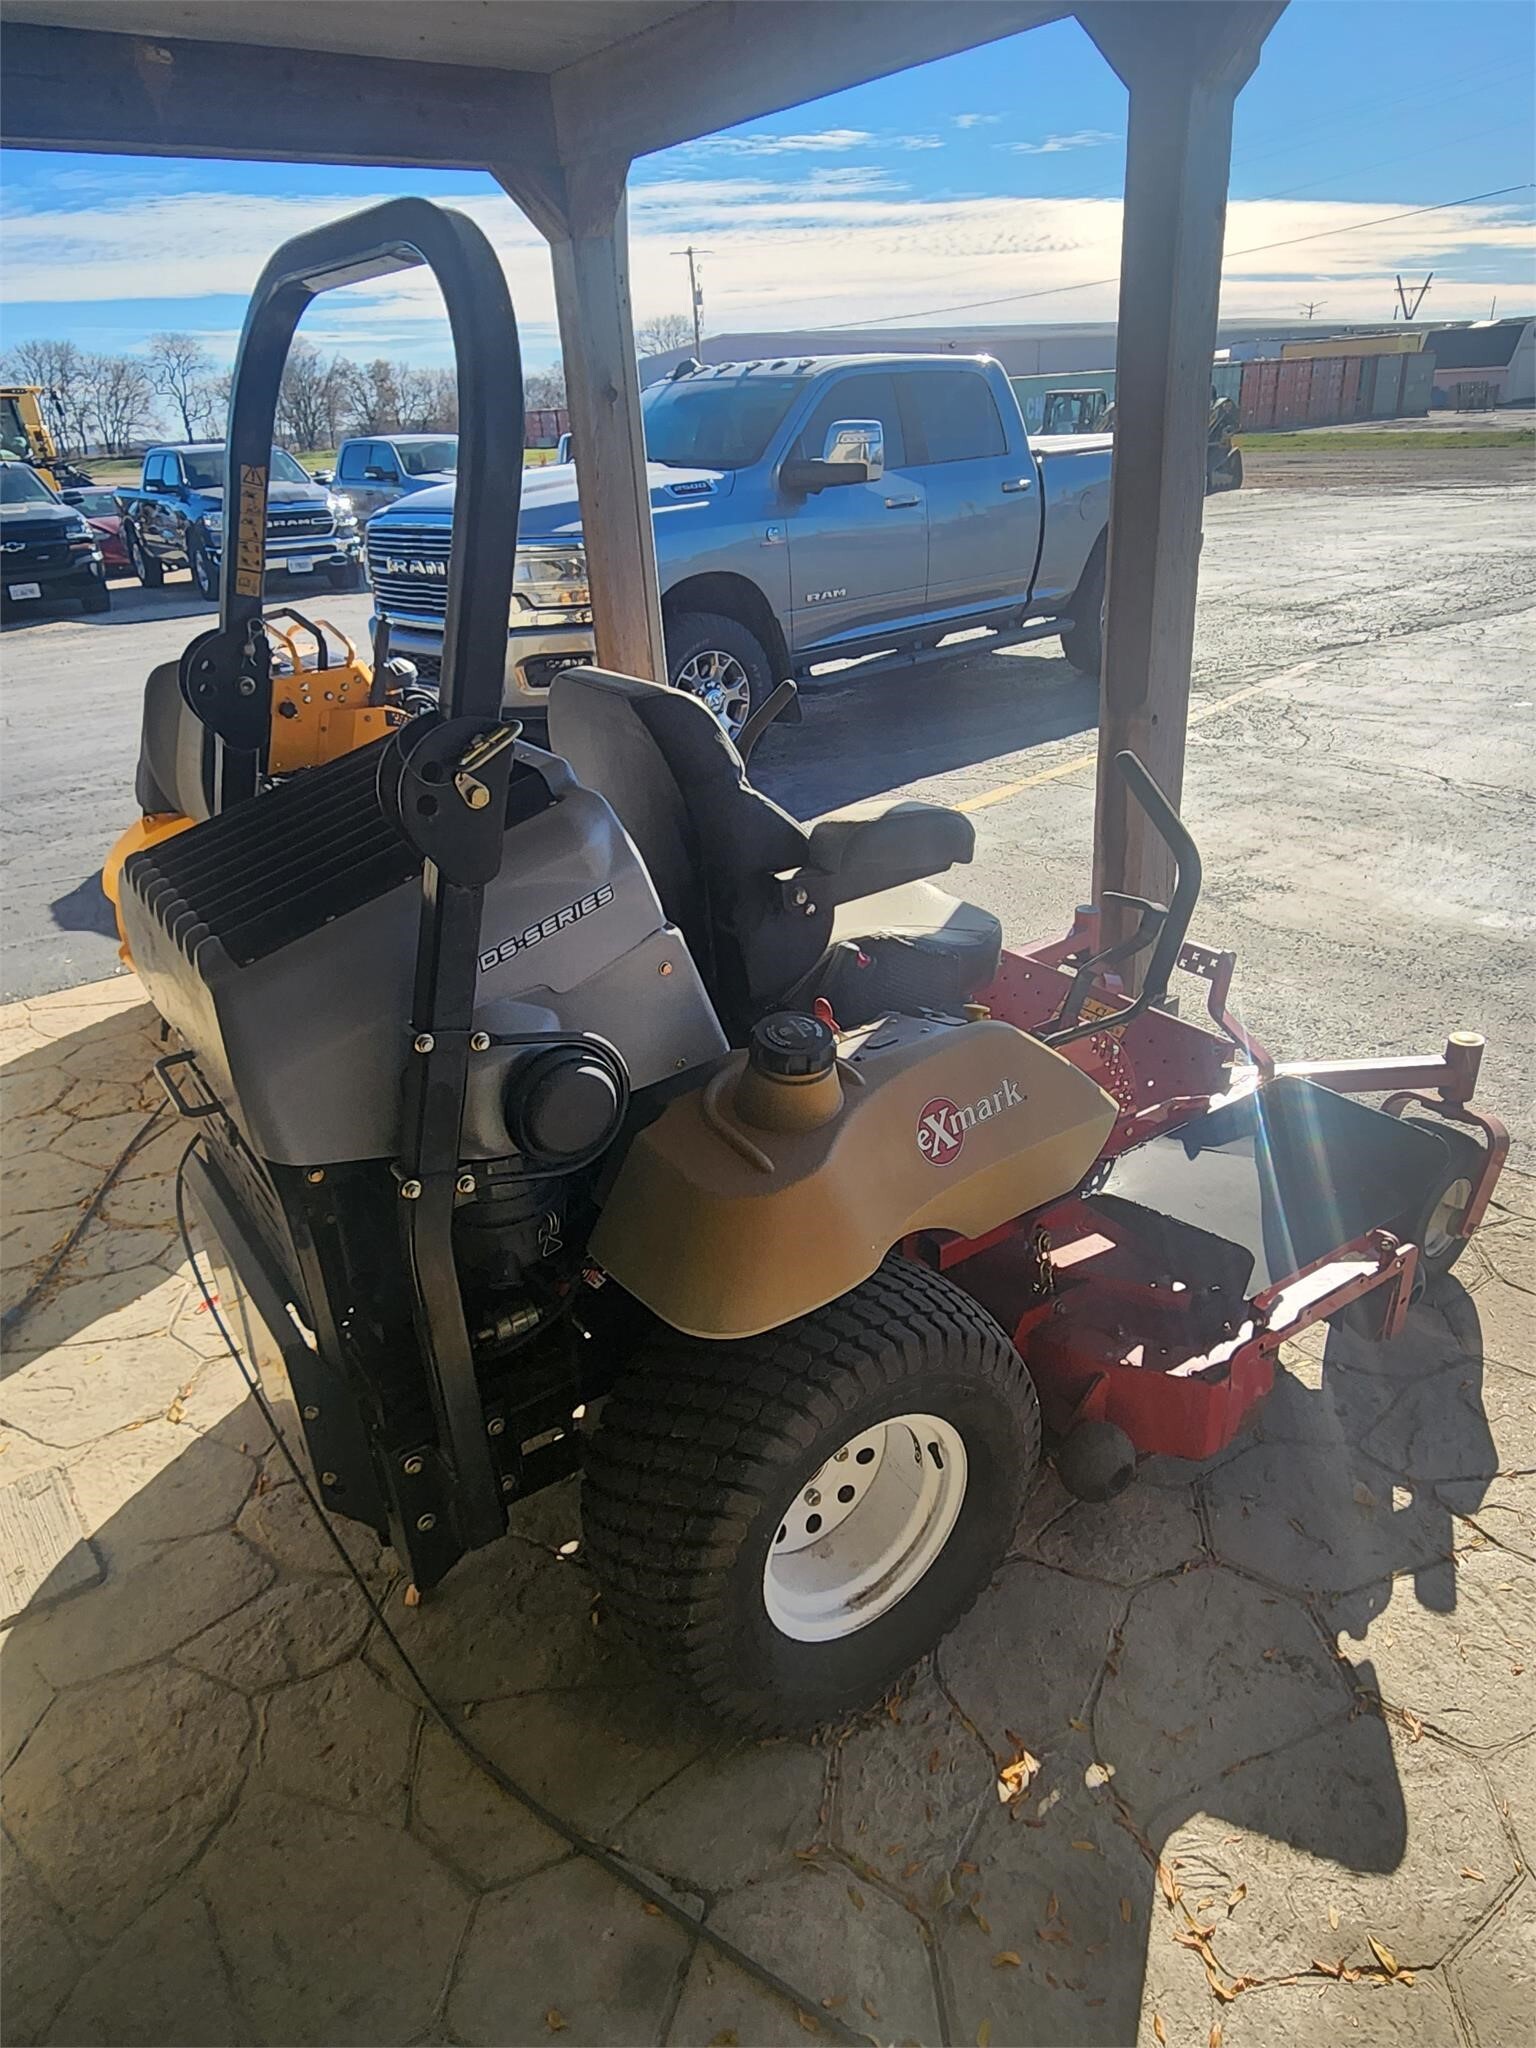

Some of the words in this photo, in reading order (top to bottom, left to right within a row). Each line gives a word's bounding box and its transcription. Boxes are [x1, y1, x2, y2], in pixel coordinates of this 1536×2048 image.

[674, 482, 708, 491] 2500
[391, 558, 447, 576] RAM
[806, 588, 847, 602] RAM
[478, 883, 615, 974] DS-SERIES
[917, 1078, 1024, 1158] eXmark
